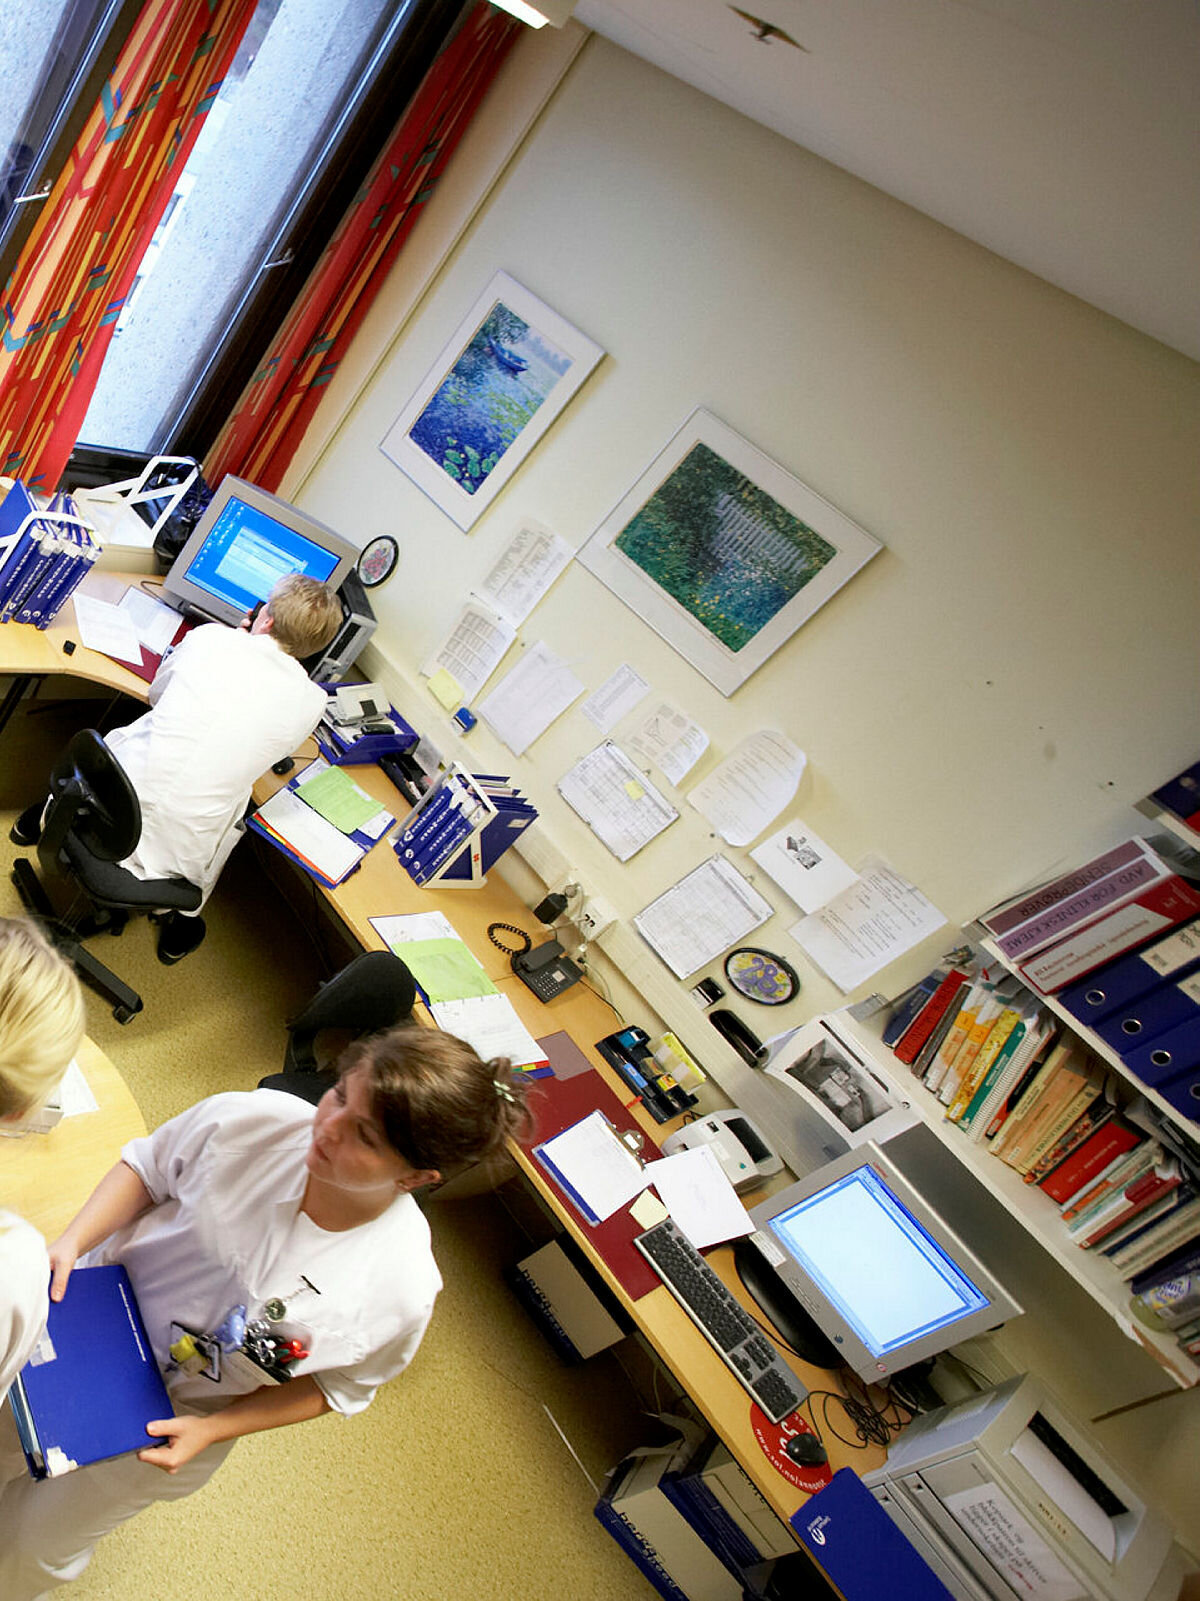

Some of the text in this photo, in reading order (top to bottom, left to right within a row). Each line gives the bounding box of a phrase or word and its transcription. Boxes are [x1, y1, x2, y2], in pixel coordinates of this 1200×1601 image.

[1091, 882, 1116, 903] FOR
[1041, 898, 1090, 930] KLINISK
[1005, 926, 1041, 950] KJEMI
